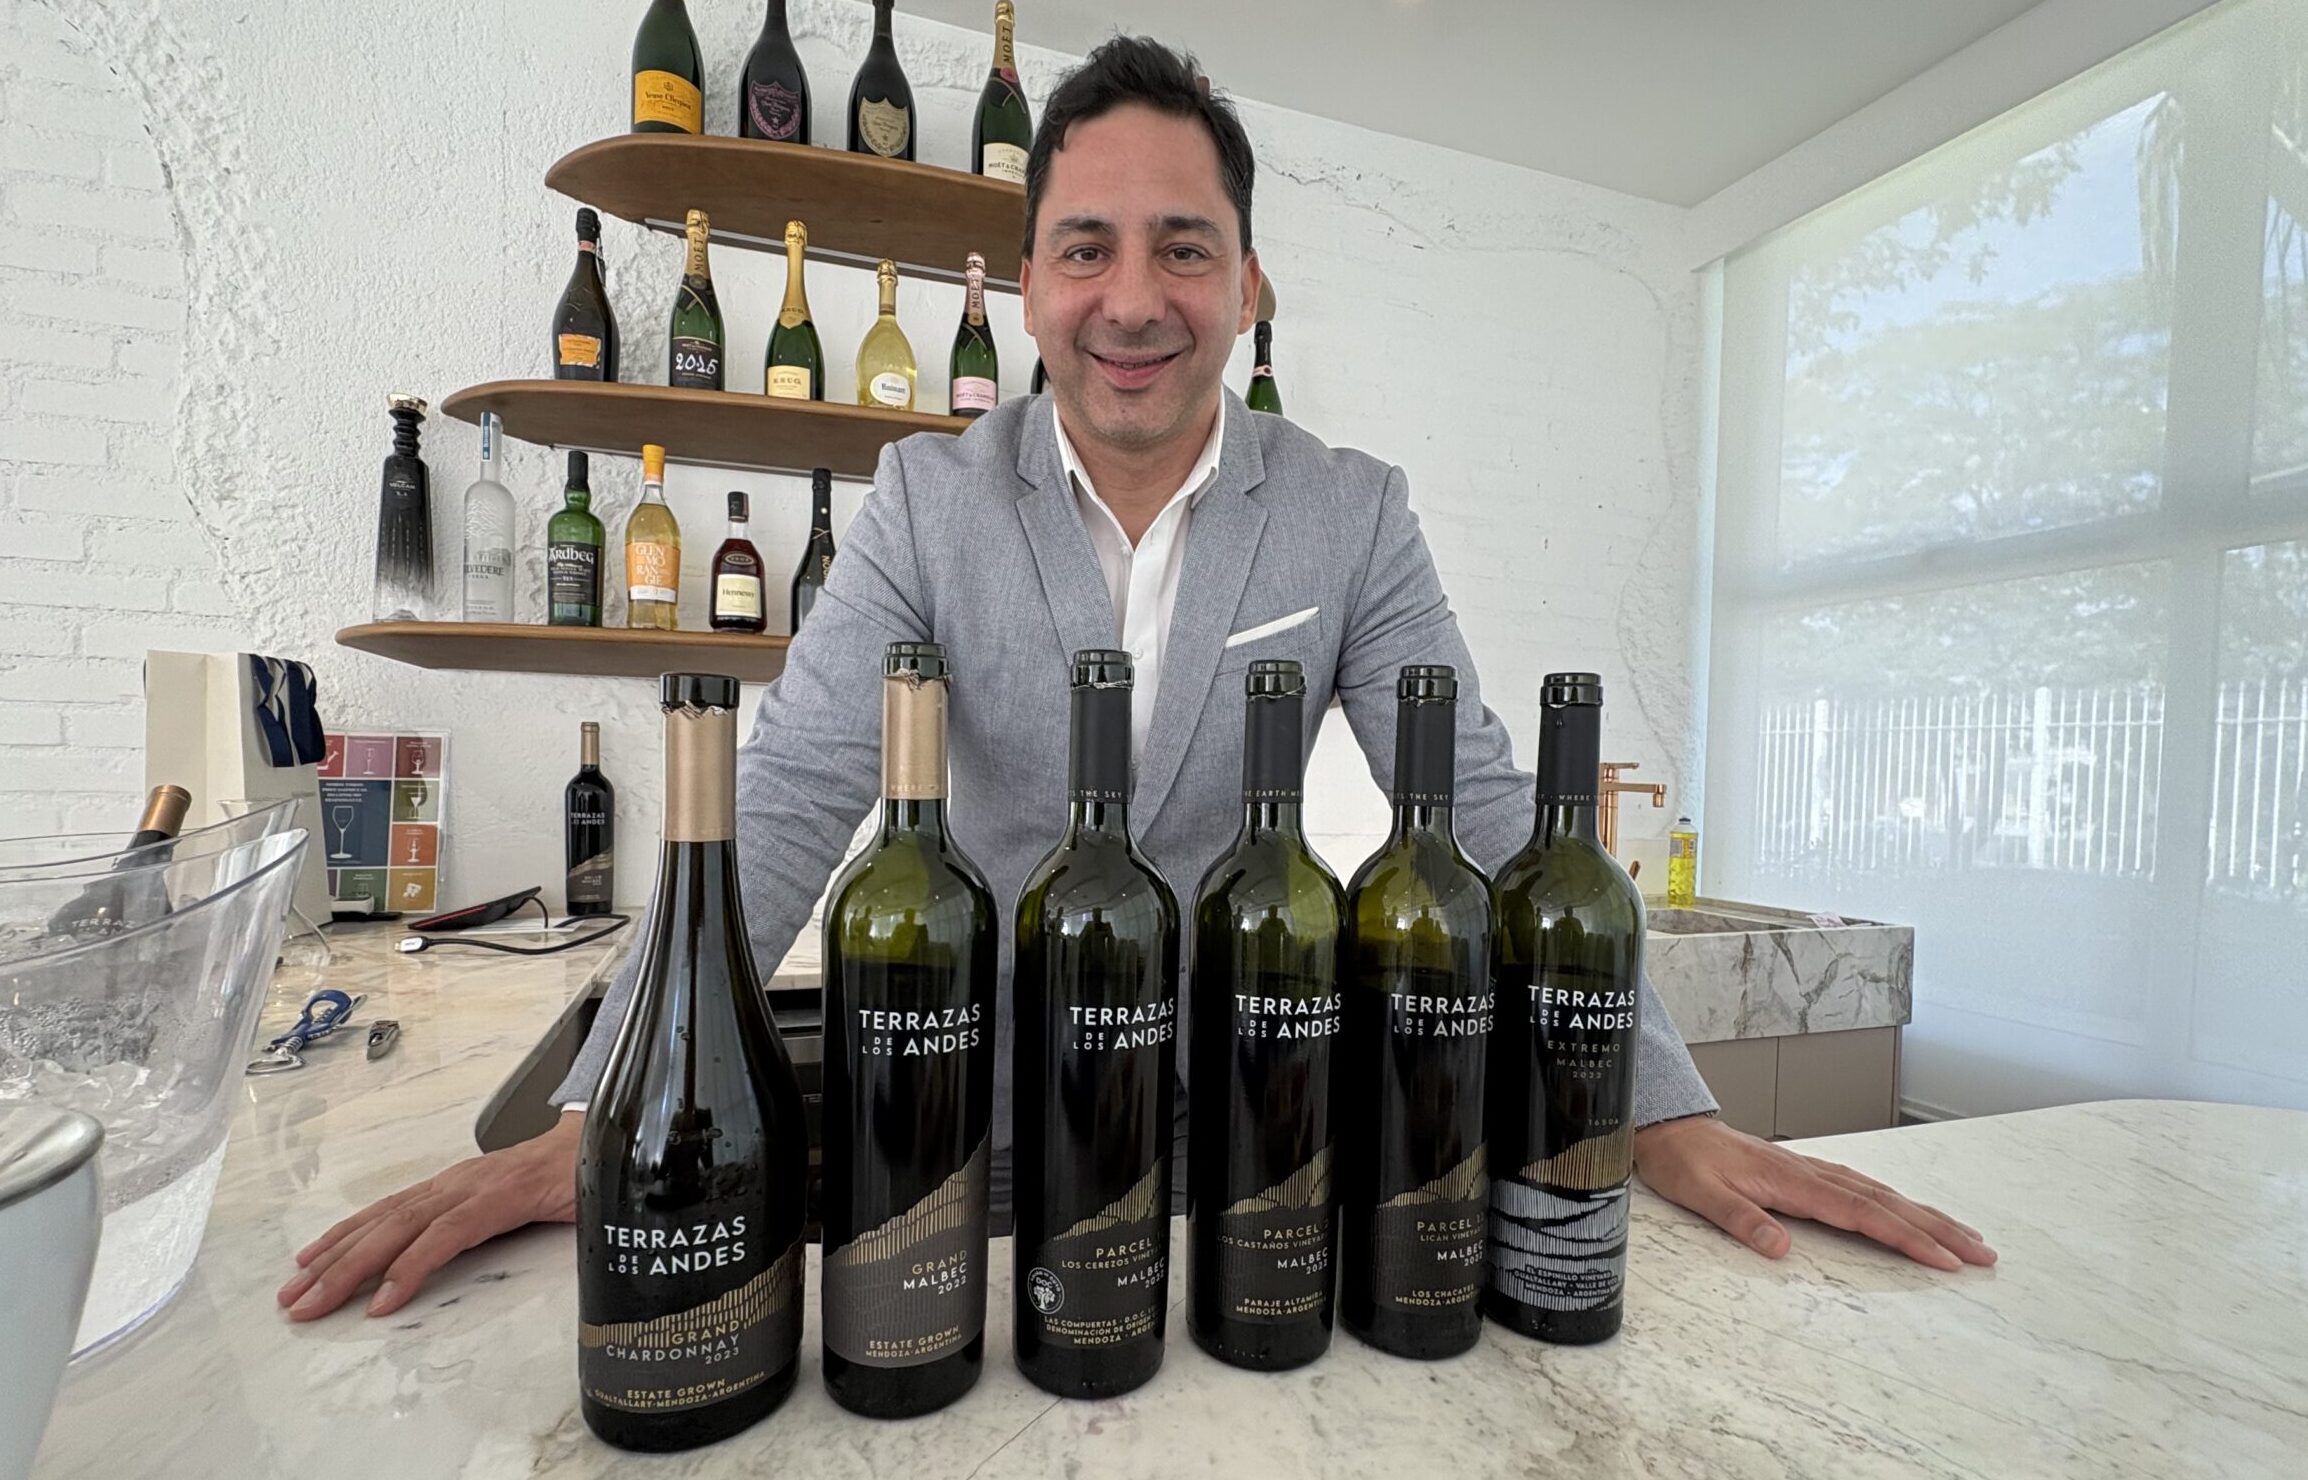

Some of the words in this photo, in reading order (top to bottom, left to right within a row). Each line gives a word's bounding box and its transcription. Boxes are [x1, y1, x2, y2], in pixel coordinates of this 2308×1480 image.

[1080, 789, 1098, 797] THE
[1104, 790, 1121, 798] SKY
[1255, 789, 1286, 797] EARTH
[1410, 792, 1427, 801] THE
[1433, 793, 1448, 801] SKY
[1391, 993, 1495, 1014] TERRAZAS
[1528, 985, 1635, 1008] TERRAZAS
[1235, 993, 1342, 1015] TERRAZAS
[859, 1003, 980, 1031] TERRAZAS
[1070, 998, 1174, 1026] TERRAZAS
[1542, 1009, 1559, 1018] DE
[1250, 1020, 1267, 1029] DE
[1276, 1016, 1341, 1039] ANDES
[1406, 1018, 1424, 1027] DE
[1433, 1015, 1494, 1037] ANDES
[1530, 1016, 1559, 1027] LOS
[1569, 1012, 1634, 1030] ANDES
[1085, 1032, 1104, 1040] DE
[1114, 1021, 1173, 1050] ANDES
[1238, 1028, 1267, 1038] LOS
[1394, 1025, 1424, 1036] LOS
[874, 1036, 893, 1046] DE
[903, 1028, 980, 1057] ANDES
[1073, 1042, 1104, 1050] LOS
[1547, 1040, 1620, 1053] EXTREMO
[862, 1046, 893, 1056] LOS
[1556, 1057, 1613, 1068] MALBEC
[1264, 1223, 1319, 1240] PARCEL
[1417, 1218, 1472, 1231] PARCEL
[604, 1215, 746, 1249] TERRAZAS
[1096, 1237, 1152, 1259] PARCEL
[1437, 1239, 1483, 1261] MALBEC
[619, 1254, 638, 1264] DE
[649, 1241, 746, 1275] ANDES
[912, 1250, 967, 1275] GRAND
[1061, 1260, 1081, 1269] LOS
[1085, 1257, 1129, 1270] CEREZOS
[1277, 1247, 1328, 1269] MALBEC
[608, 1262, 639, 1275] LOS
[1117, 1256, 1165, 1287] MALBEC
[903, 1262, 967, 1290] MALBEC
[1412, 1290, 1430, 1298] LOS
[1525, 1282, 1565, 1296] MENDOZA
[1244, 1298, 1281, 1307] PARAJE
[1044, 1316, 1059, 1325] LAS
[1060, 1319, 1117, 1328] COMPUERTAS
[671, 1320, 740, 1345] GRAND
[1046, 1324, 1111, 1336] DENOMINACIÓN
[1113, 1325, 1124, 1333] DE
[869, 1340, 913, 1350] ESTATE
[918, 1325, 960, 1346] GROWN
[1073, 1334, 1121, 1345] MENDOZA
[605, 1334, 740, 1361] CHARDONNAY
[705, 1347, 740, 1364] 2023
[627, 1389, 671, 1399] ESTATE
[676, 1378, 727, 1397] GROWN
